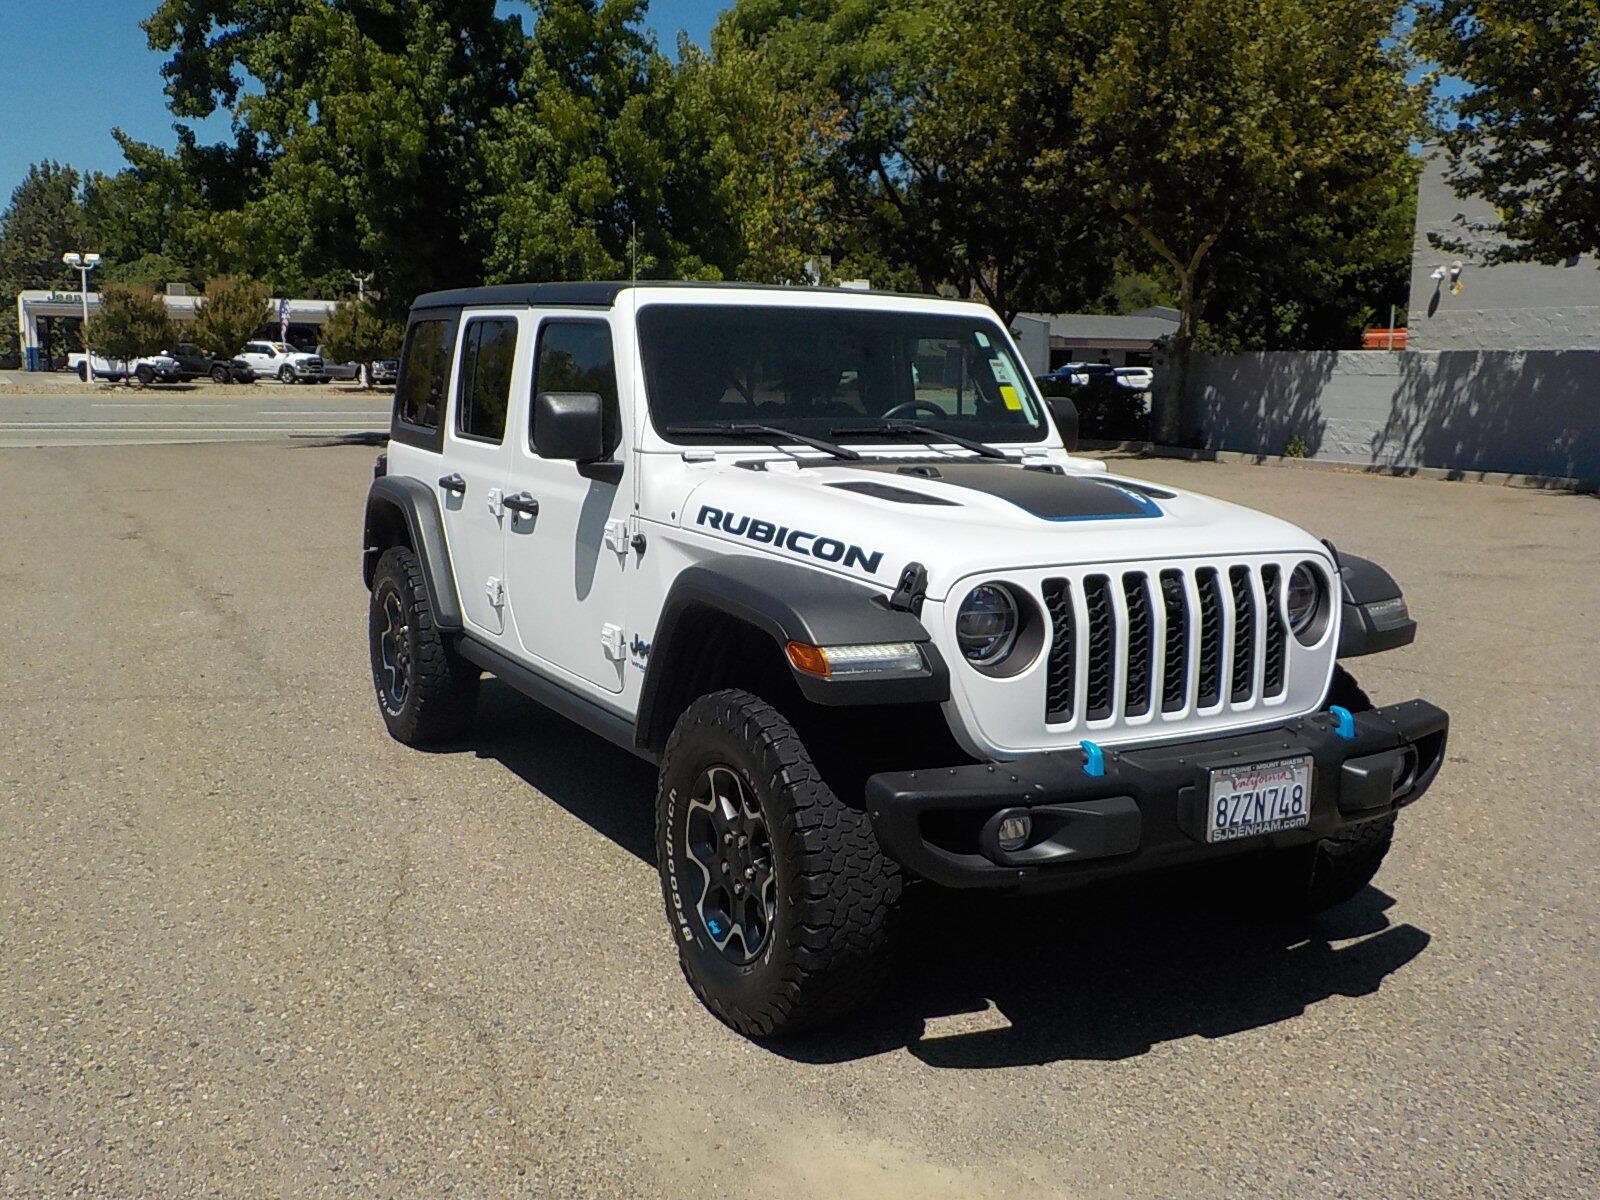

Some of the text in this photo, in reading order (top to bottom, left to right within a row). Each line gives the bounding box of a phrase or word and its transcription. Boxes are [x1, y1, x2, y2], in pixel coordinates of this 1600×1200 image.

[696, 504, 885, 575] RUBICON
[1213, 816, 1306, 841] SJDENHAM.com
[1215, 784, 1304, 828] 8ZZN748
[665, 787, 694, 942] BFGoodrich
